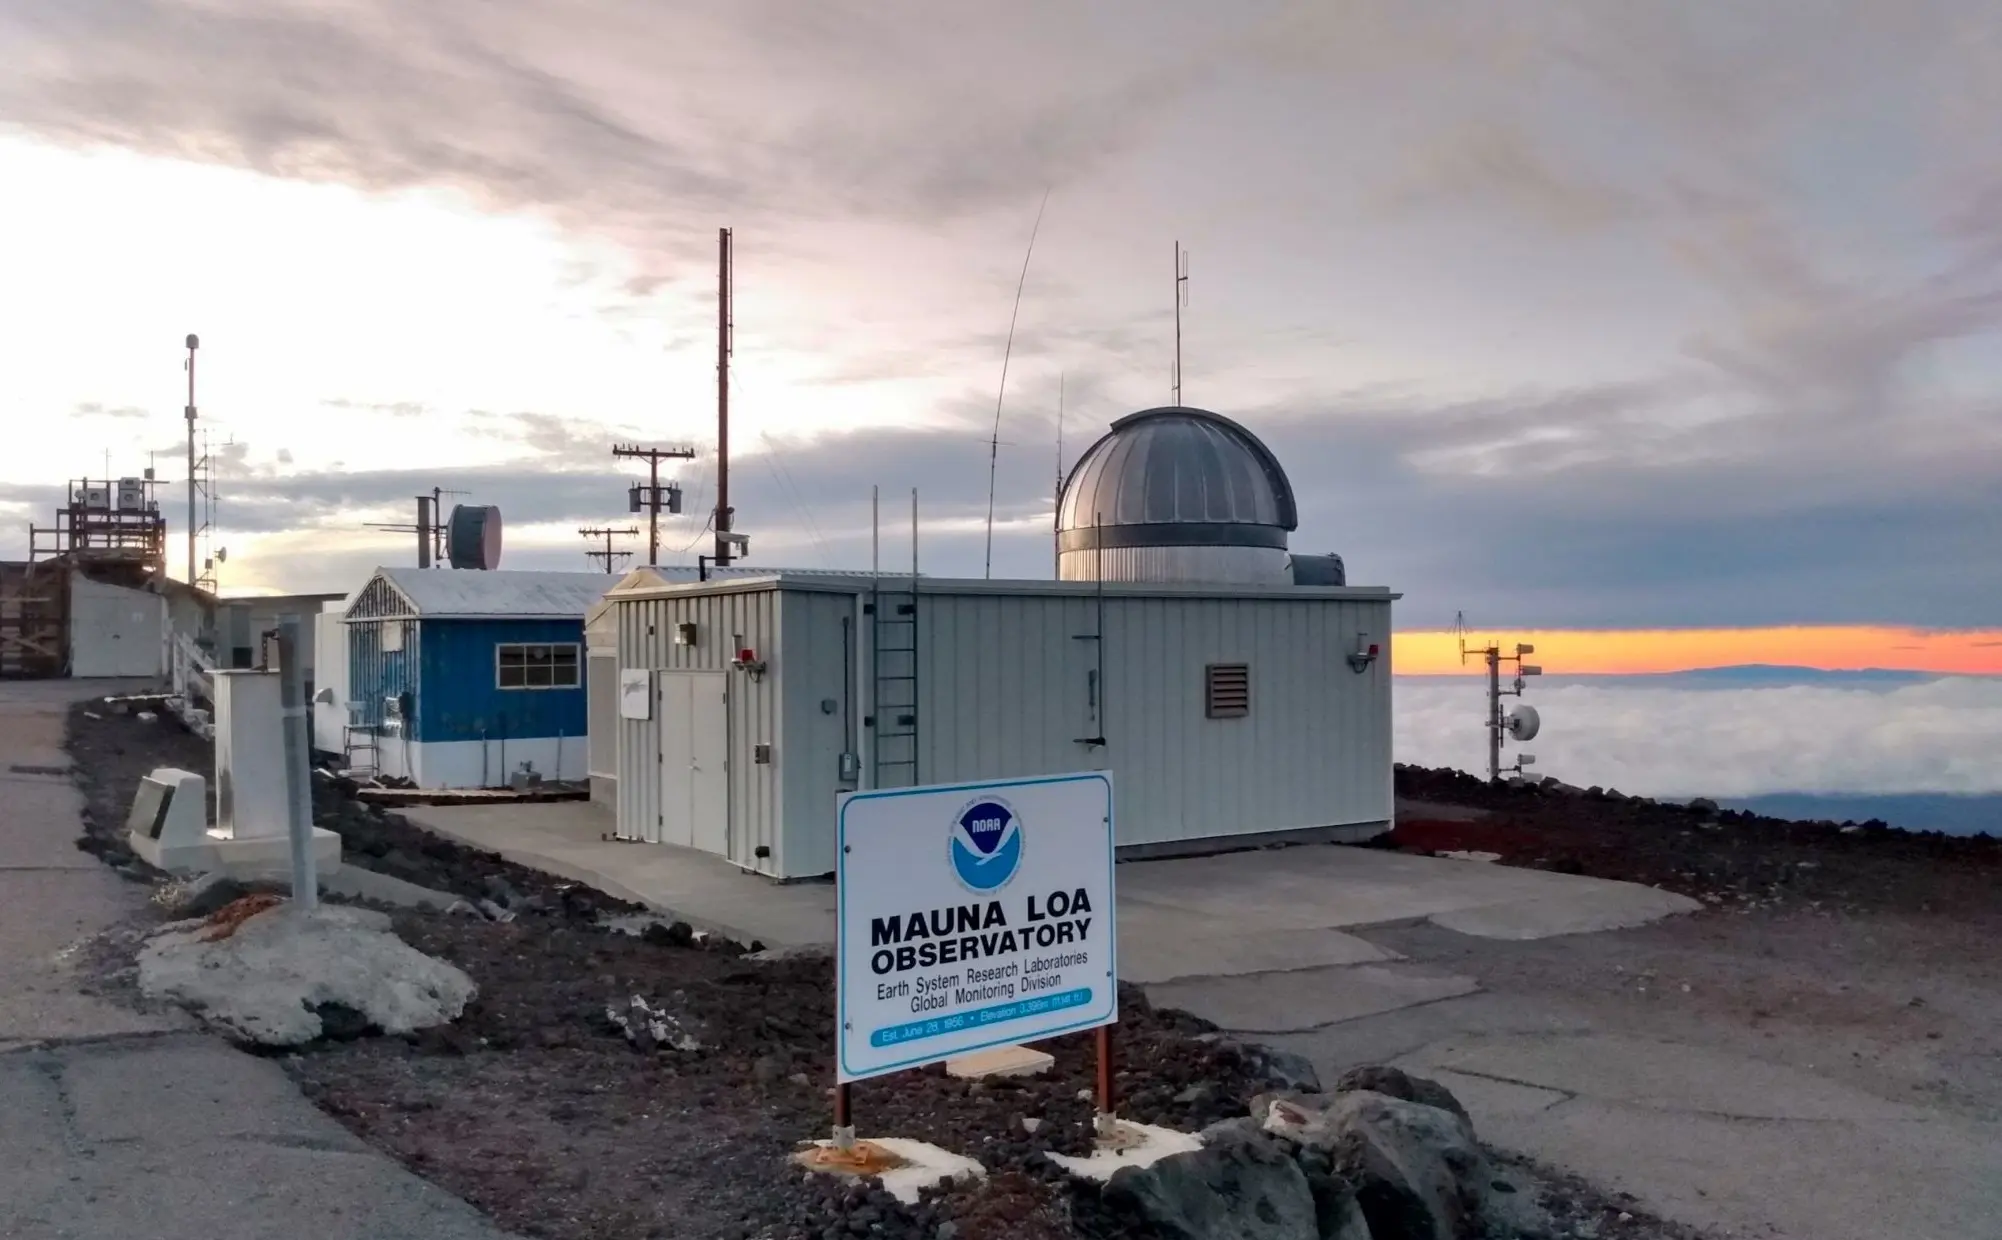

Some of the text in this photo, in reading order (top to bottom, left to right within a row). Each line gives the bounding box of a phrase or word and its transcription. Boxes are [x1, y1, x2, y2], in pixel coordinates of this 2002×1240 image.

[972, 818, 1000, 833] NOAA
[871, 900, 1006, 946] MAUNA
[1028, 888, 1091, 921] LOA
[871, 918, 1091, 975] OBSERVATORY
[877, 951, 1088, 1000] Earth System Research Laboratories
[911, 973, 1061, 1013] Global Monitoring Division
[902, 1026, 923, 1038] June
[980, 1006, 1016, 1022] Elevation
